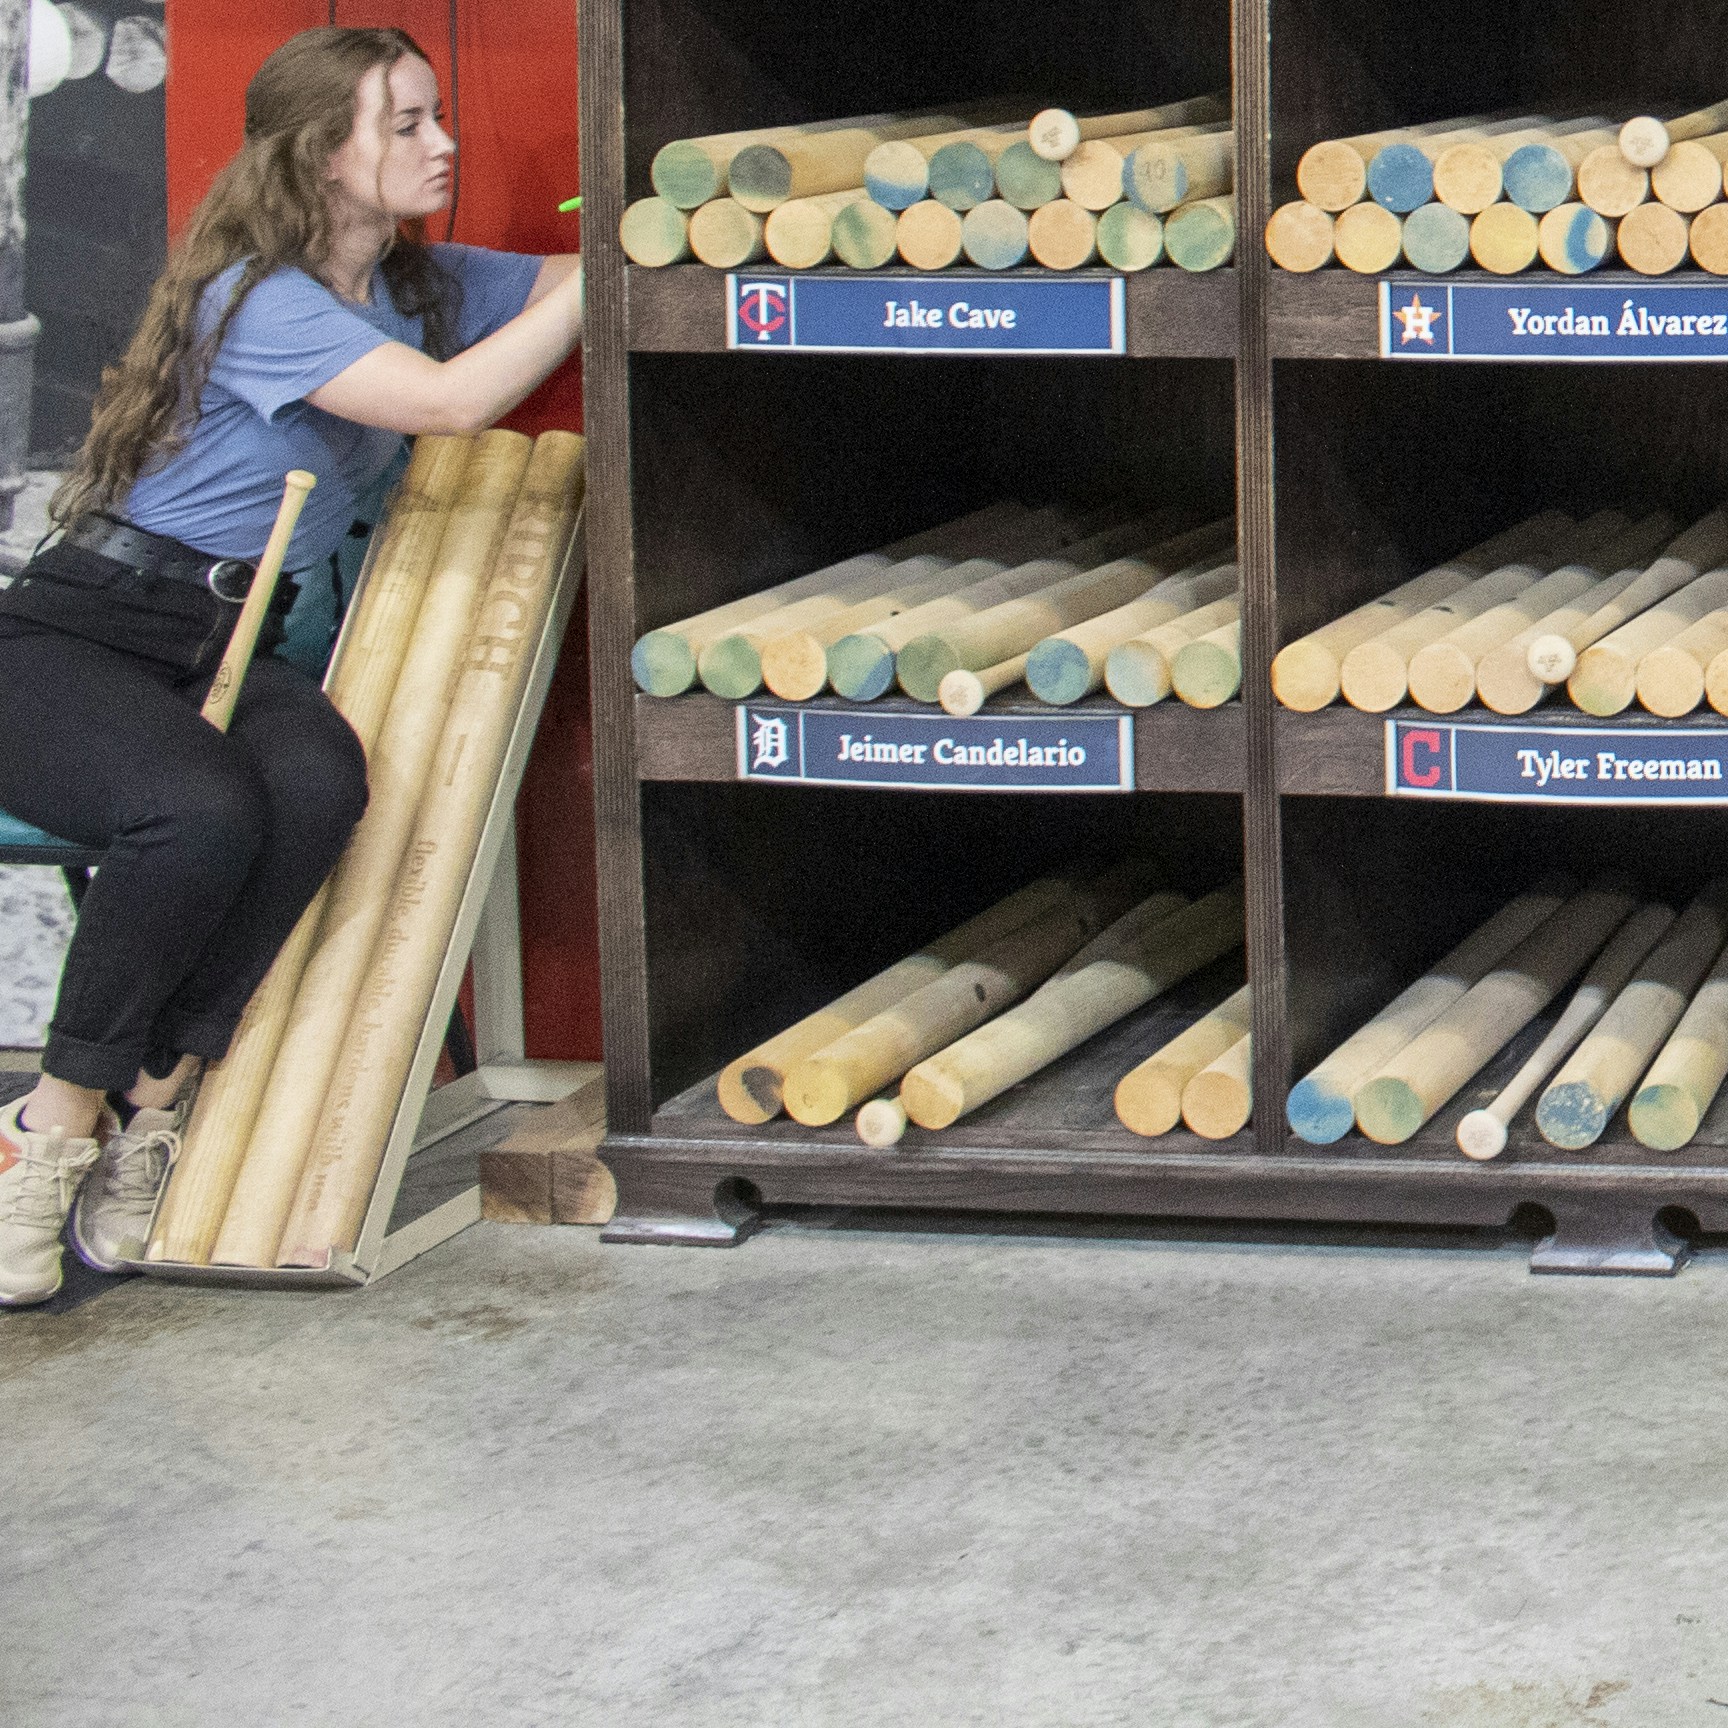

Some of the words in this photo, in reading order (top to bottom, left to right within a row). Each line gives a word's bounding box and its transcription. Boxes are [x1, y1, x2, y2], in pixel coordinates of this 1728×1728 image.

[884, 301, 942, 328] Jake
[949, 302, 1015, 328] Cave
[1402, 305, 1433, 340] H
[1508, 308, 1609, 335] Yordan
[838, 735, 927, 764] Jeimer
[933, 739, 1085, 766] Candelario
[1403, 731, 1440, 786] C
[1517, 750, 1589, 786] Tyler
[1597, 753, 1721, 780] Freeman
